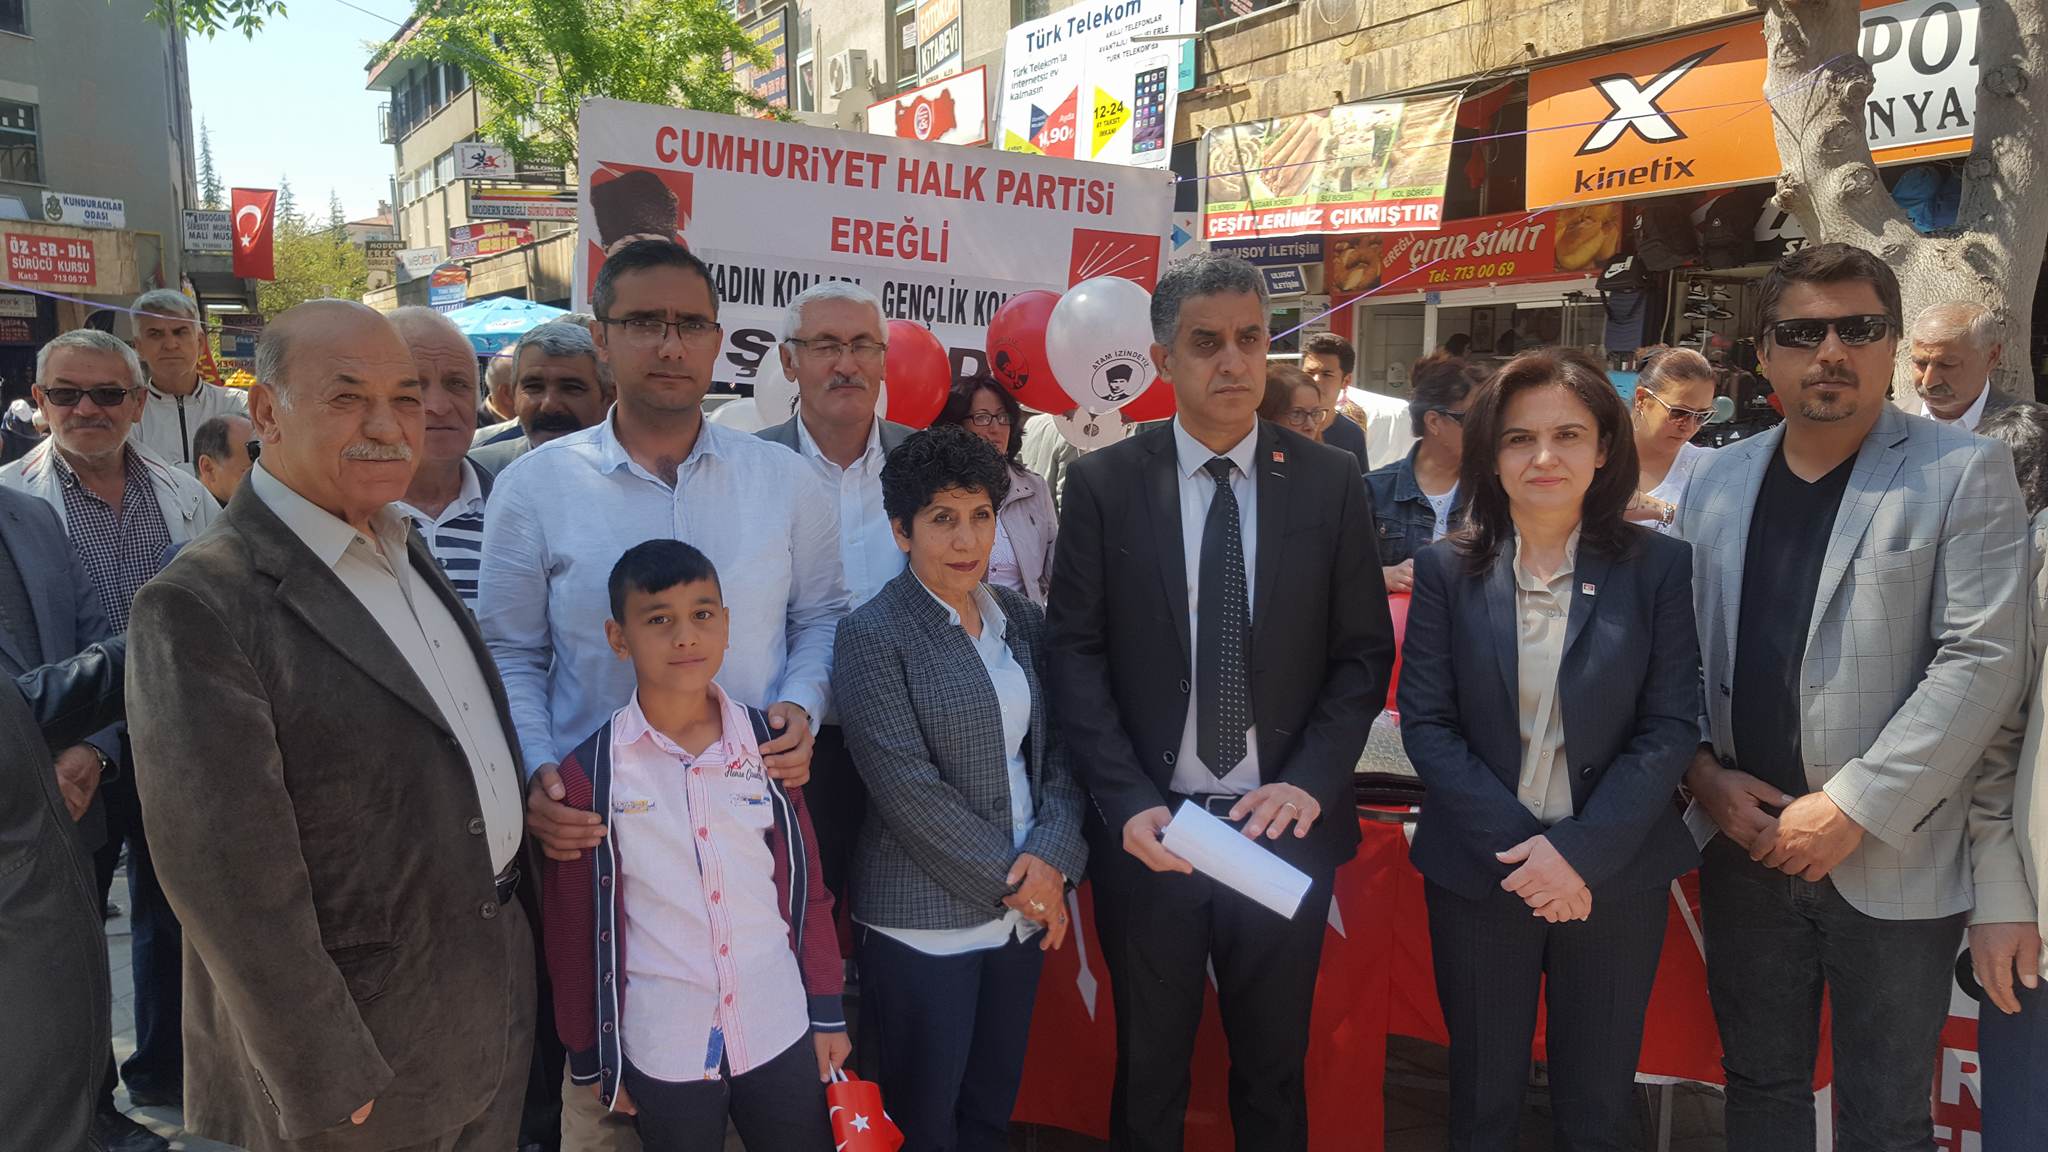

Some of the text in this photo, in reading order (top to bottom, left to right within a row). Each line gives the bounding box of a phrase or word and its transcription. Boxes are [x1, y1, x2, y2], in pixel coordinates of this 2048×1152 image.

[1026, 0, 1141, 53] Türk Telekom
[1094, 100, 1124, 119] 12-24
[897, 156, 988, 202] HALK
[1574, 155, 1695, 194] kinetix
[63, 196, 122, 212] KUNDURACILAR
[84, 209, 109, 221] ODASI
[1209, 203, 1439, 237] ÇEŞİTLERİMİZ ÇIKMIŞTIR
[9, 236, 29, 255] ÖZ
[39, 242, 57, 256] ER
[68, 241, 90, 259] DİL
[831, 215, 949, 263] EREĞLİ
[1269, 239, 1320, 257] İLETİŞİM
[1382, 231, 1416, 268] EREĞLİ
[1408, 217, 1546, 271] ÇITIR SİMİT
[12, 255, 90, 273] SÜRÜCÜ KURSU
[1428, 261, 1516, 283] Tel: 713 00 69
[881, 279, 969, 331] GENÇLİK
[1092, 353, 1113, 370] ATAM
